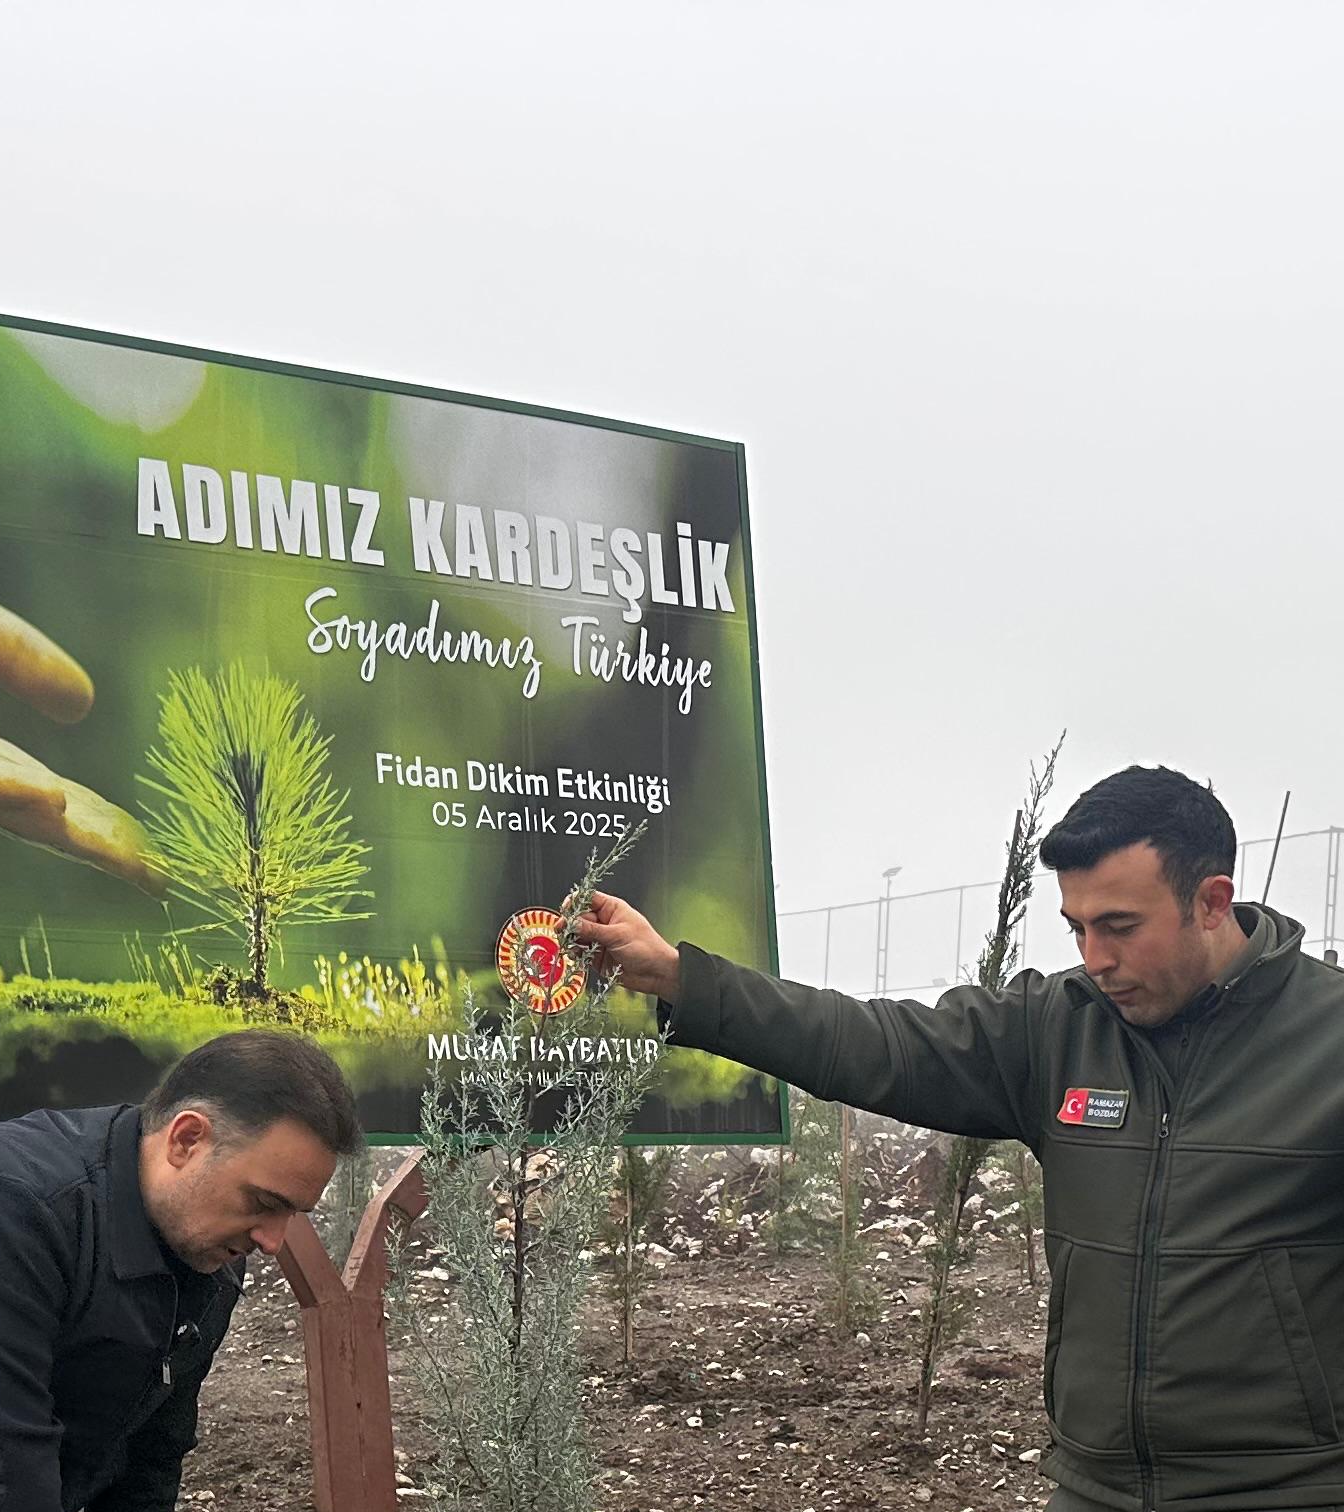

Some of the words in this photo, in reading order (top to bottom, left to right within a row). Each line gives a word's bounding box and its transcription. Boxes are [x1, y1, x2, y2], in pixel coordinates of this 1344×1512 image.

[136, 456, 385, 567] ADIMIZ
[408, 496, 736, 624] KARDEŞLİK
[303, 586, 543, 698] Soyadımız
[561, 614, 713, 714] Türkiye
[375, 752, 459, 790] Fidan
[466, 760, 550, 797] Dikim
[556, 767, 672, 814] Etkinliği
[431, 801, 468, 828] 05
[475, 804, 557, 834] Aralık
[563, 811, 626, 838] 2025
